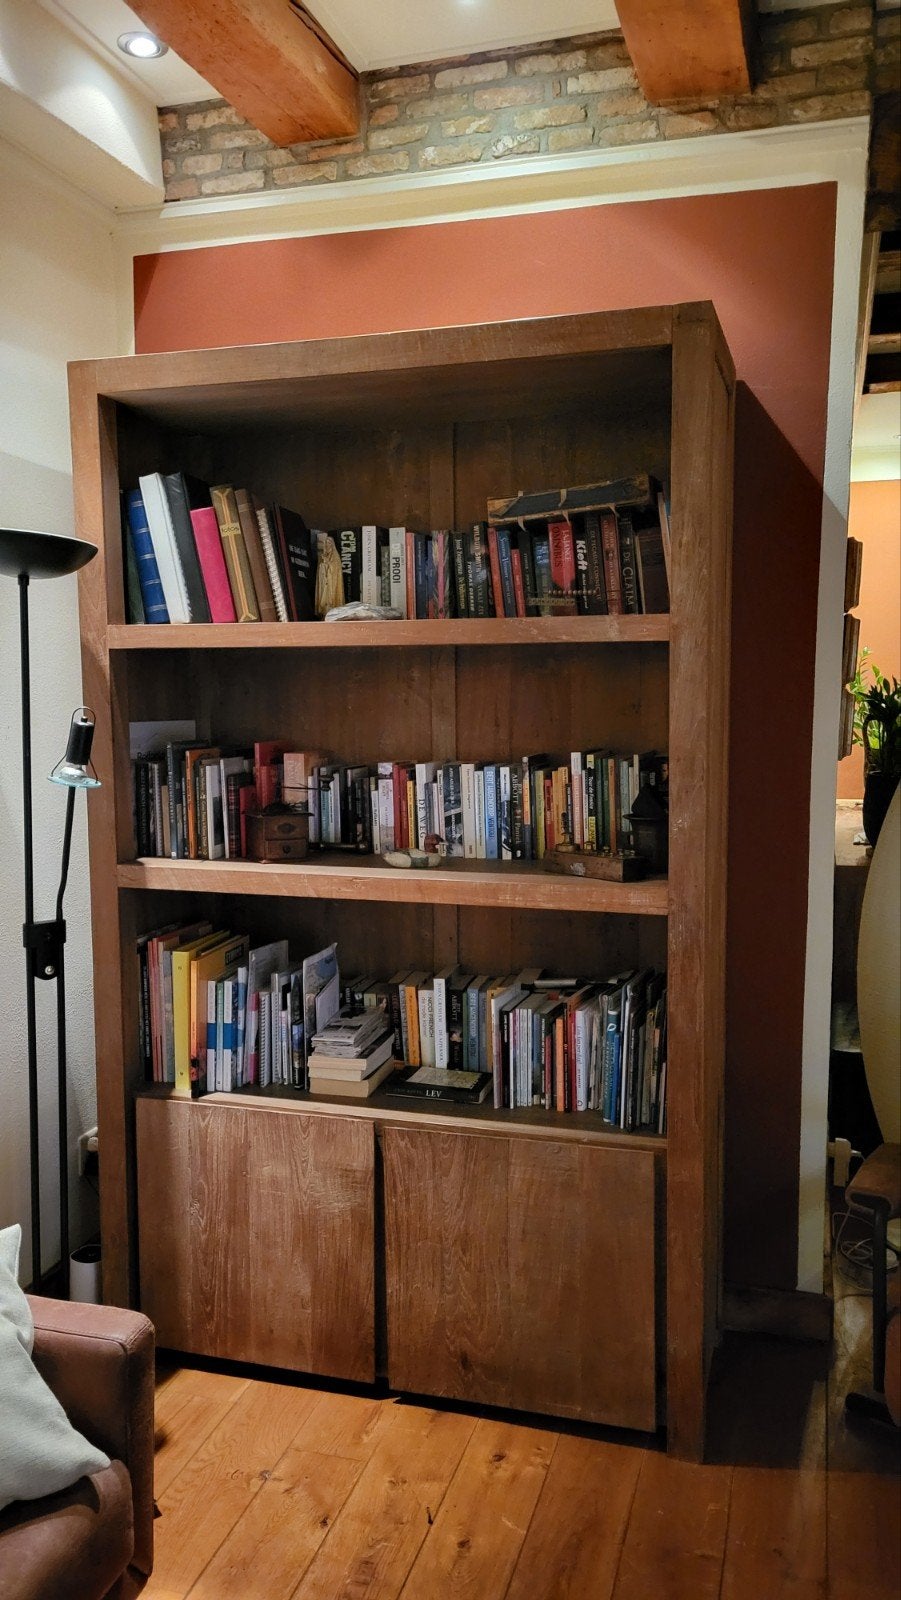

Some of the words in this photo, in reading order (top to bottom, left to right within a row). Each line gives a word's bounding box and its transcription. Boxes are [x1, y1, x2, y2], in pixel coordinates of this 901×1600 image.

[341, 531, 355, 574] CLANCY
[552, 526, 564, 568] OMNIBUS
[576, 540, 588, 570] Kieft
[623, 552, 630, 562] DE
[392, 557, 401, 584] PROOI
[622, 567, 634, 606] CLAIM
[486, 771, 494, 784] BERT
[419, 798, 425, 812] DE
[426, 1090, 442, 1098] LEV
